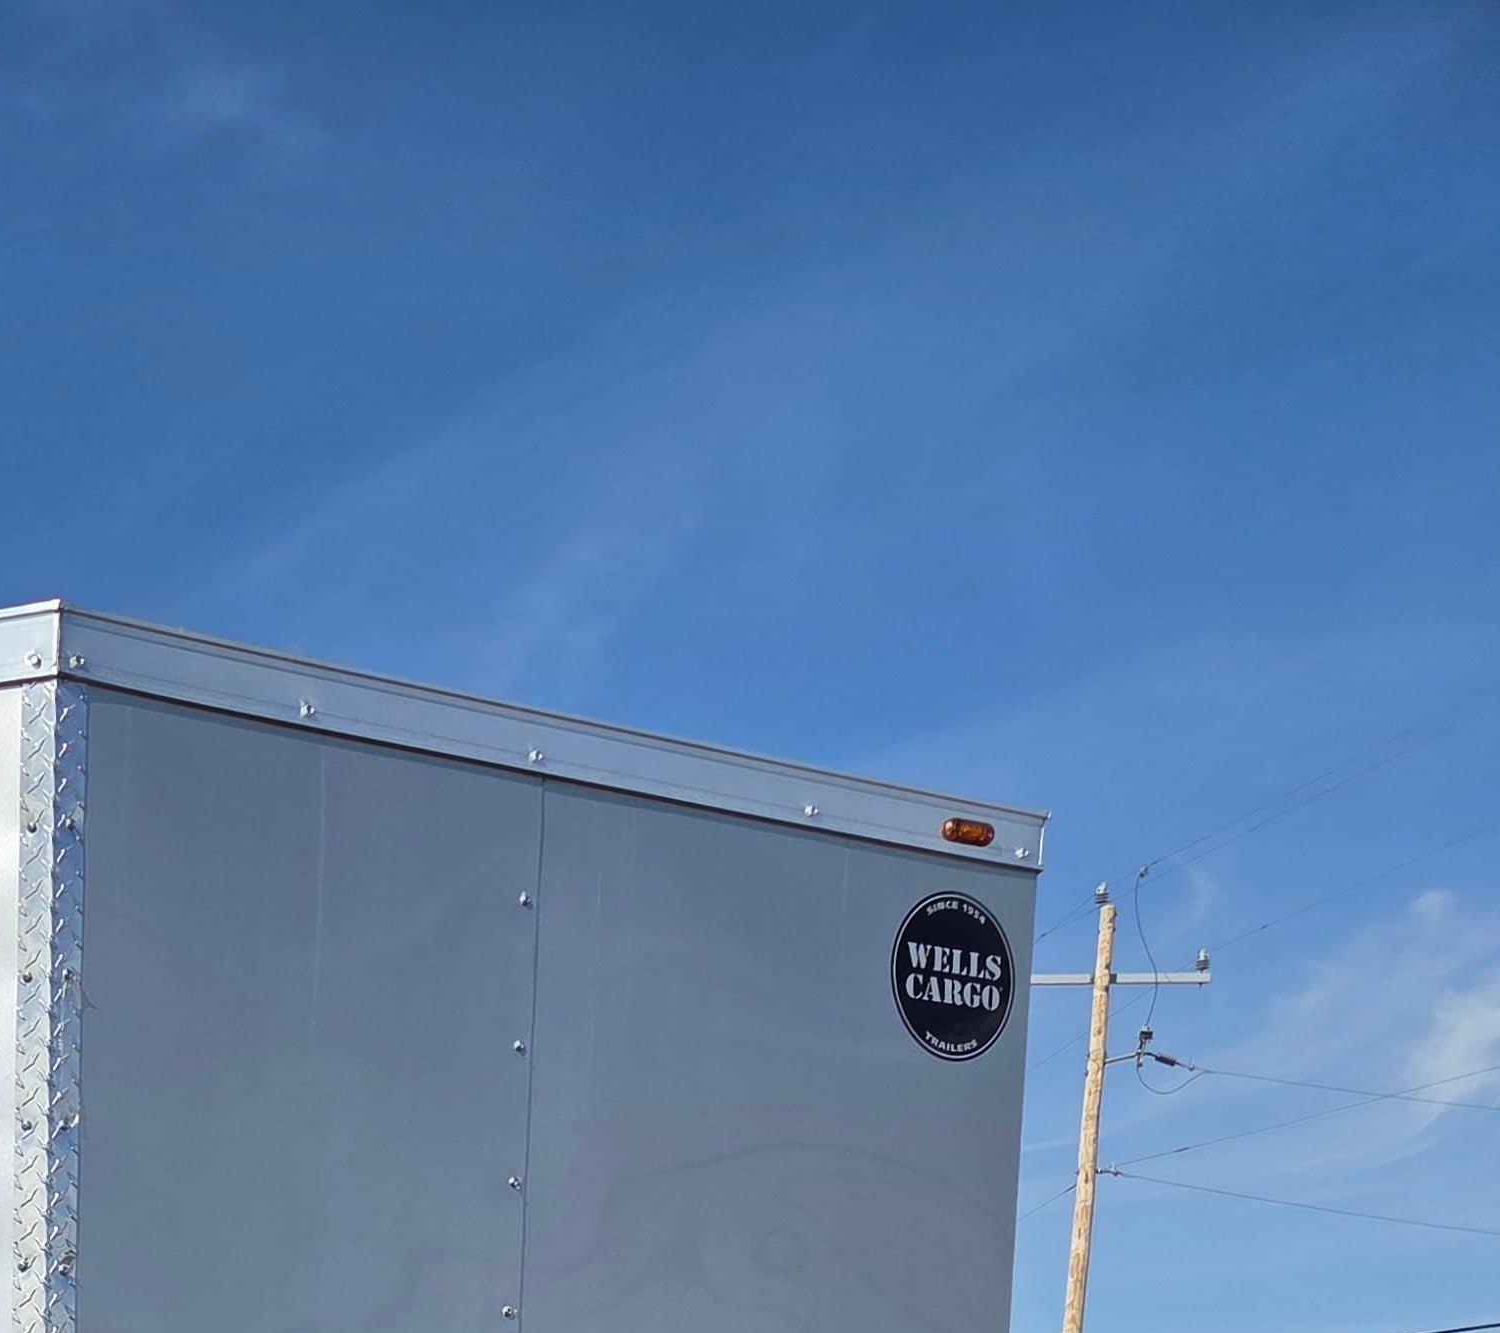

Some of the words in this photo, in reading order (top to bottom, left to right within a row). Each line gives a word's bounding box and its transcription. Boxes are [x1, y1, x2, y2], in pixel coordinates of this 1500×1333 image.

[926, 900, 959, 916] SINCE
[962, 903, 986, 925] 1954
[907, 941, 1002, 981] WELLS
[905, 973, 1001, 1012] CARGO
[925, 1030, 978, 1053] TRAILERS
